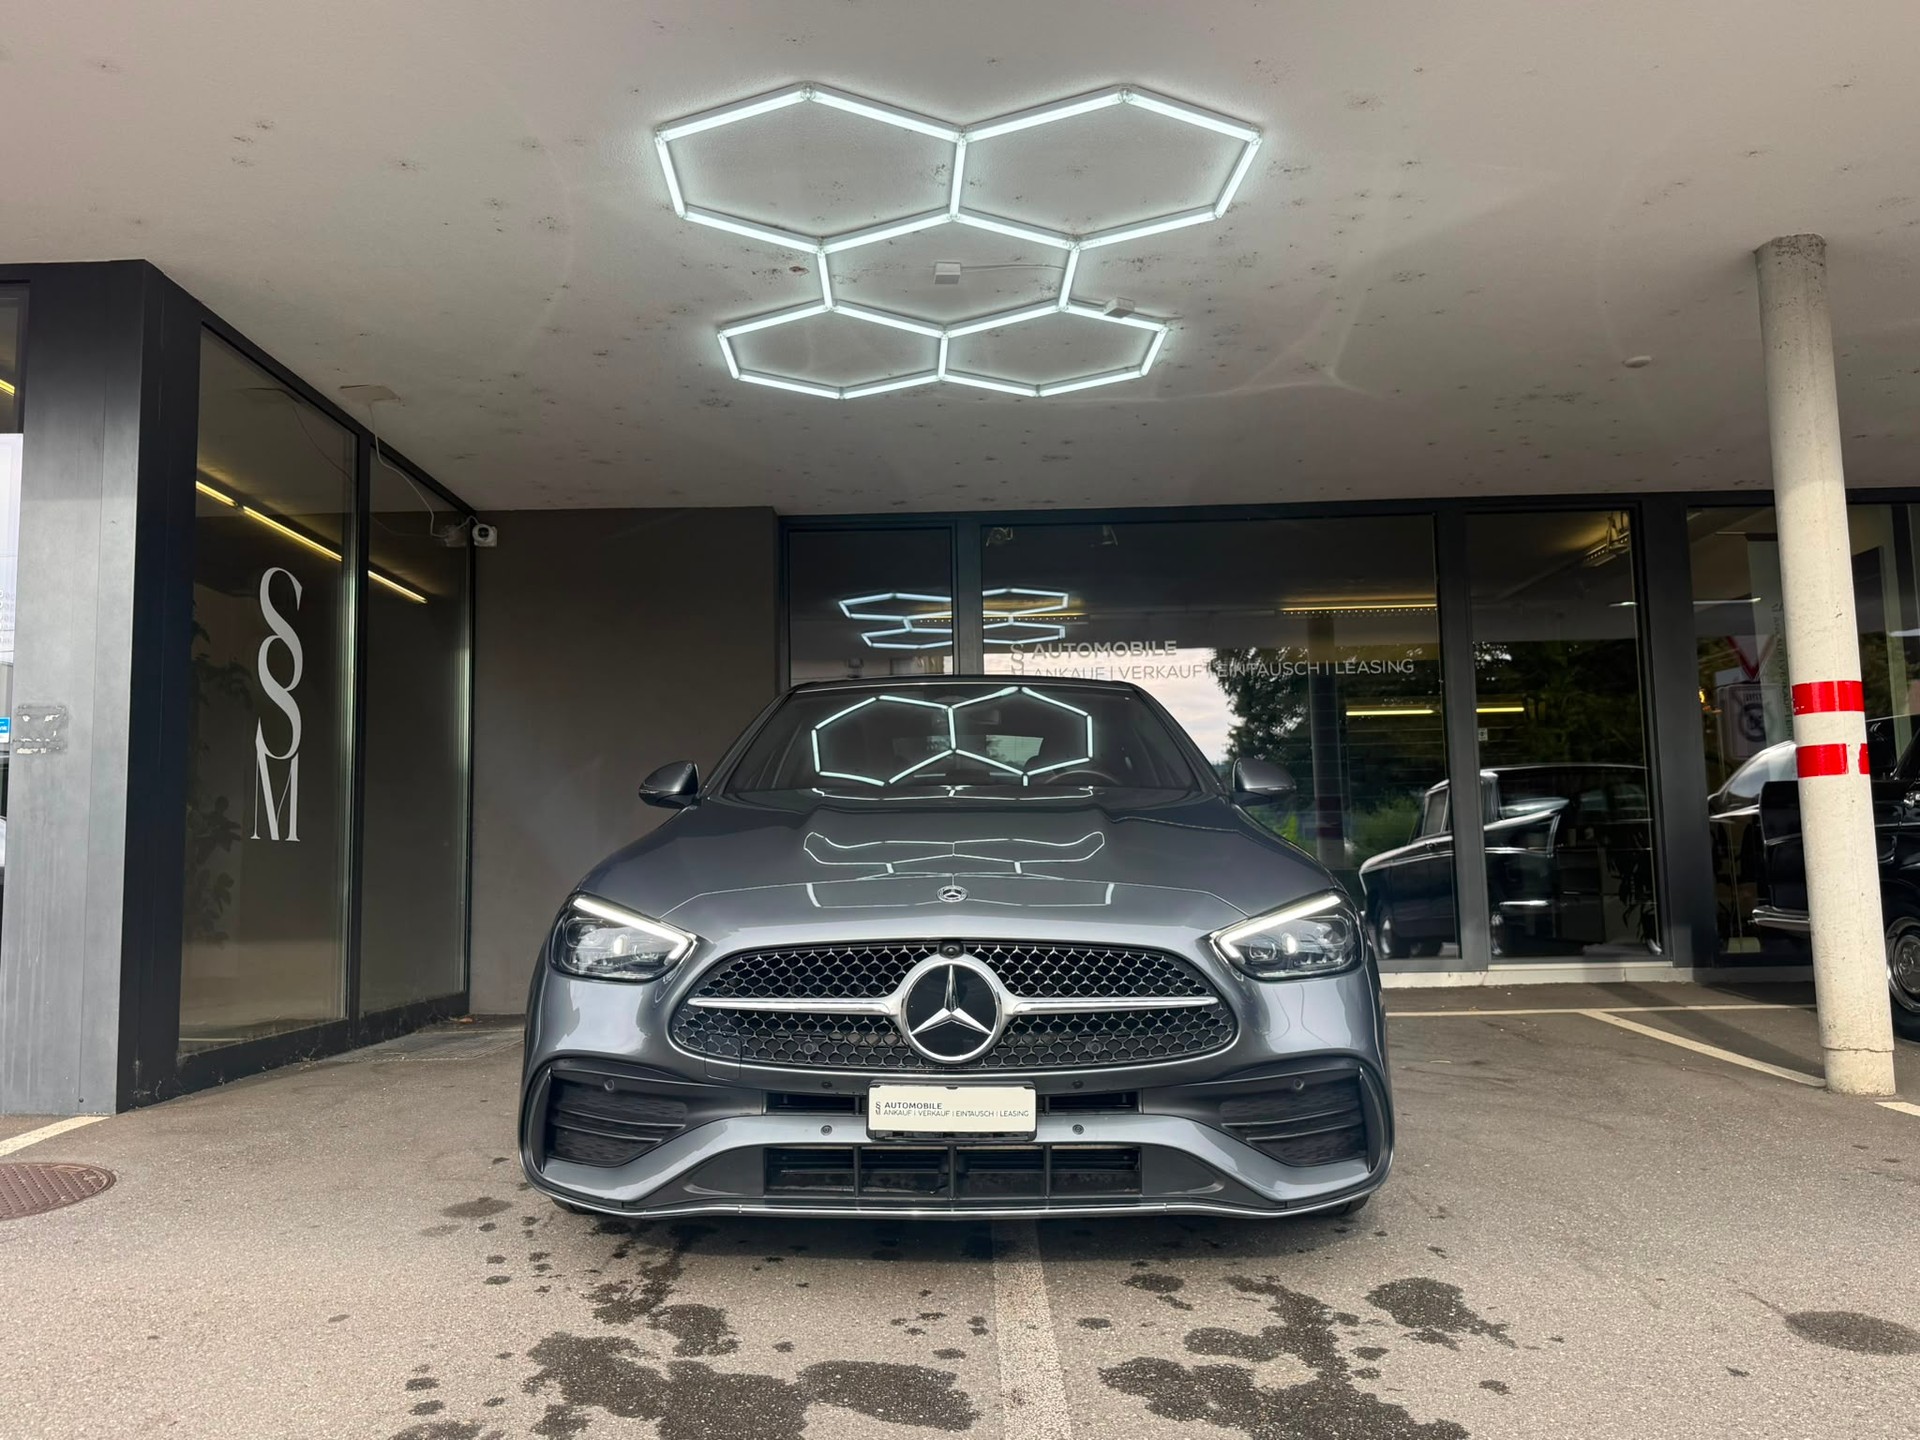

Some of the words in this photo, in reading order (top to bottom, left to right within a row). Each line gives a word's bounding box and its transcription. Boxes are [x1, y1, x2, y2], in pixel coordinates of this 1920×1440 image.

[1031, 640, 1177, 660] AUTOMOBILE
[1118, 664, 1203, 680] VERKAUF
[1217, 661, 1320, 678] EINTAUSCH
[1335, 658, 1415, 675] LEASING
[884, 1101, 943, 1110] AUTOMOBILE
